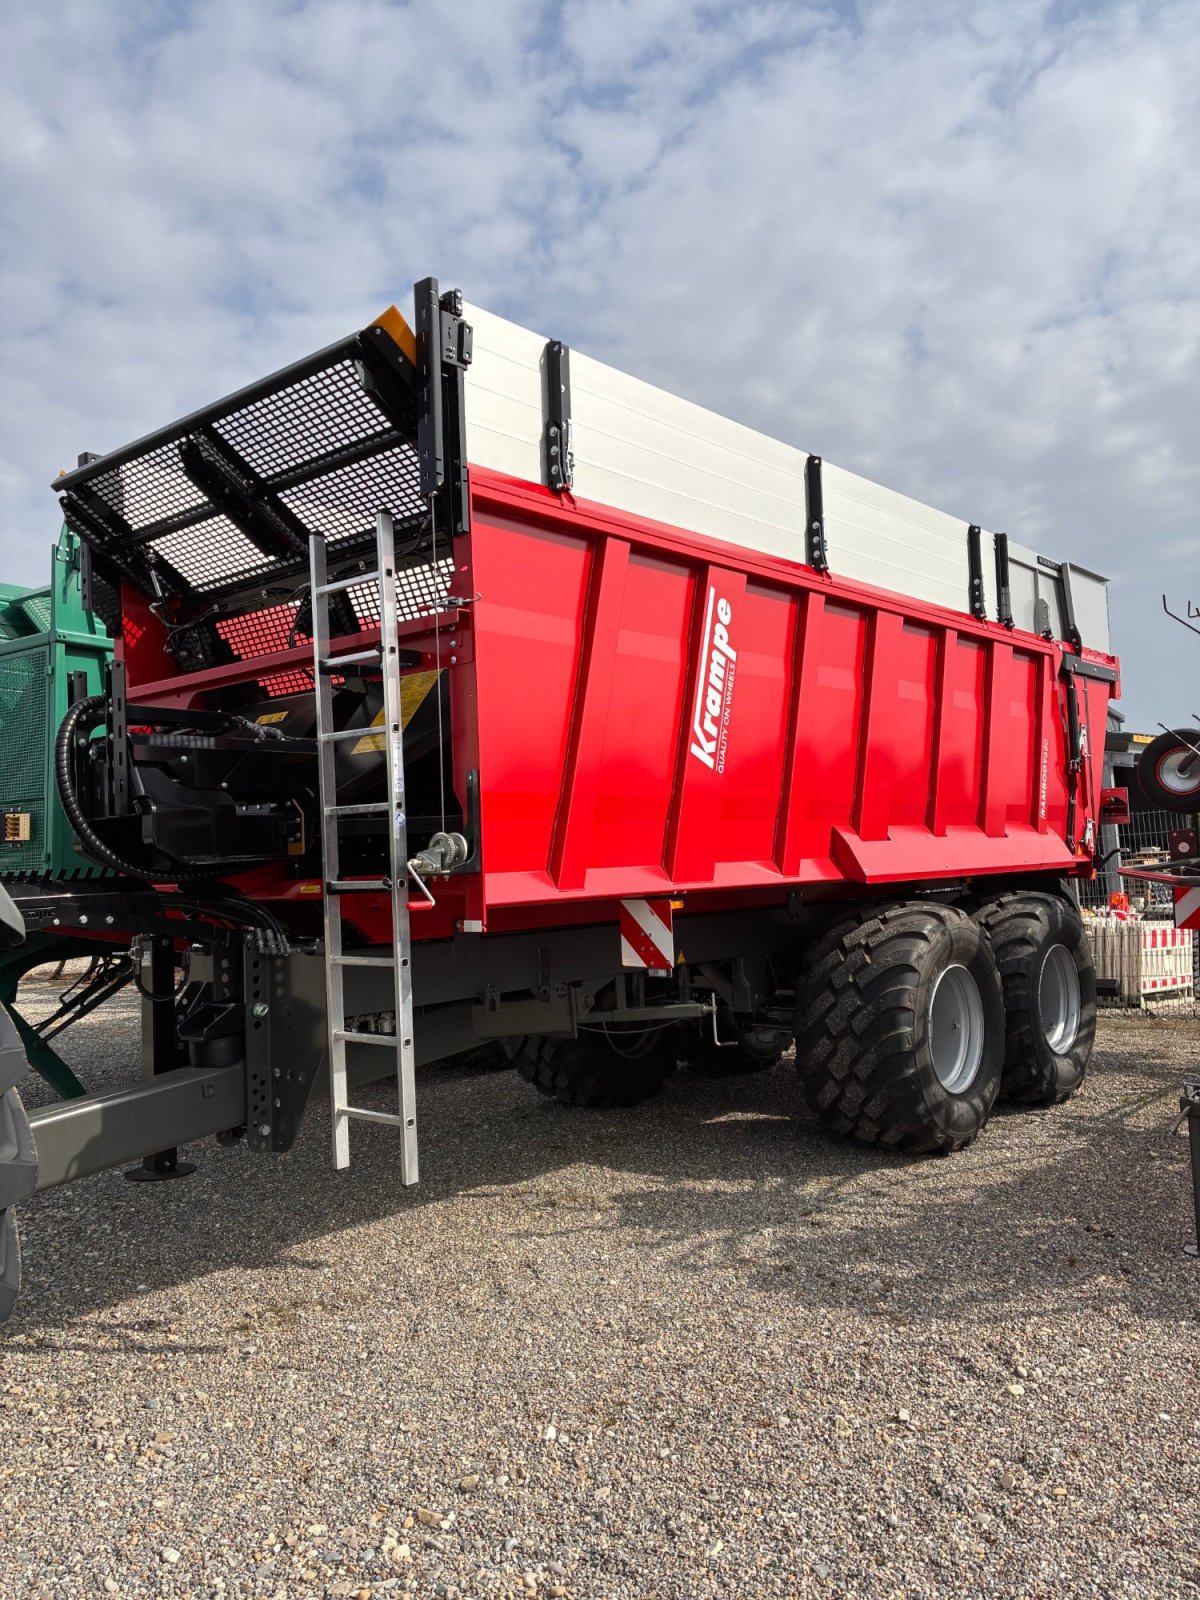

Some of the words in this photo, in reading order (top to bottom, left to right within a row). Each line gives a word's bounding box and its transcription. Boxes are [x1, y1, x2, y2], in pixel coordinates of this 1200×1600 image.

[690, 586, 737, 770] Krampe
[725, 663, 736, 705] WHEELS
[723, 707, 731, 726] ON
[718, 727, 728, 774] QUALITY
